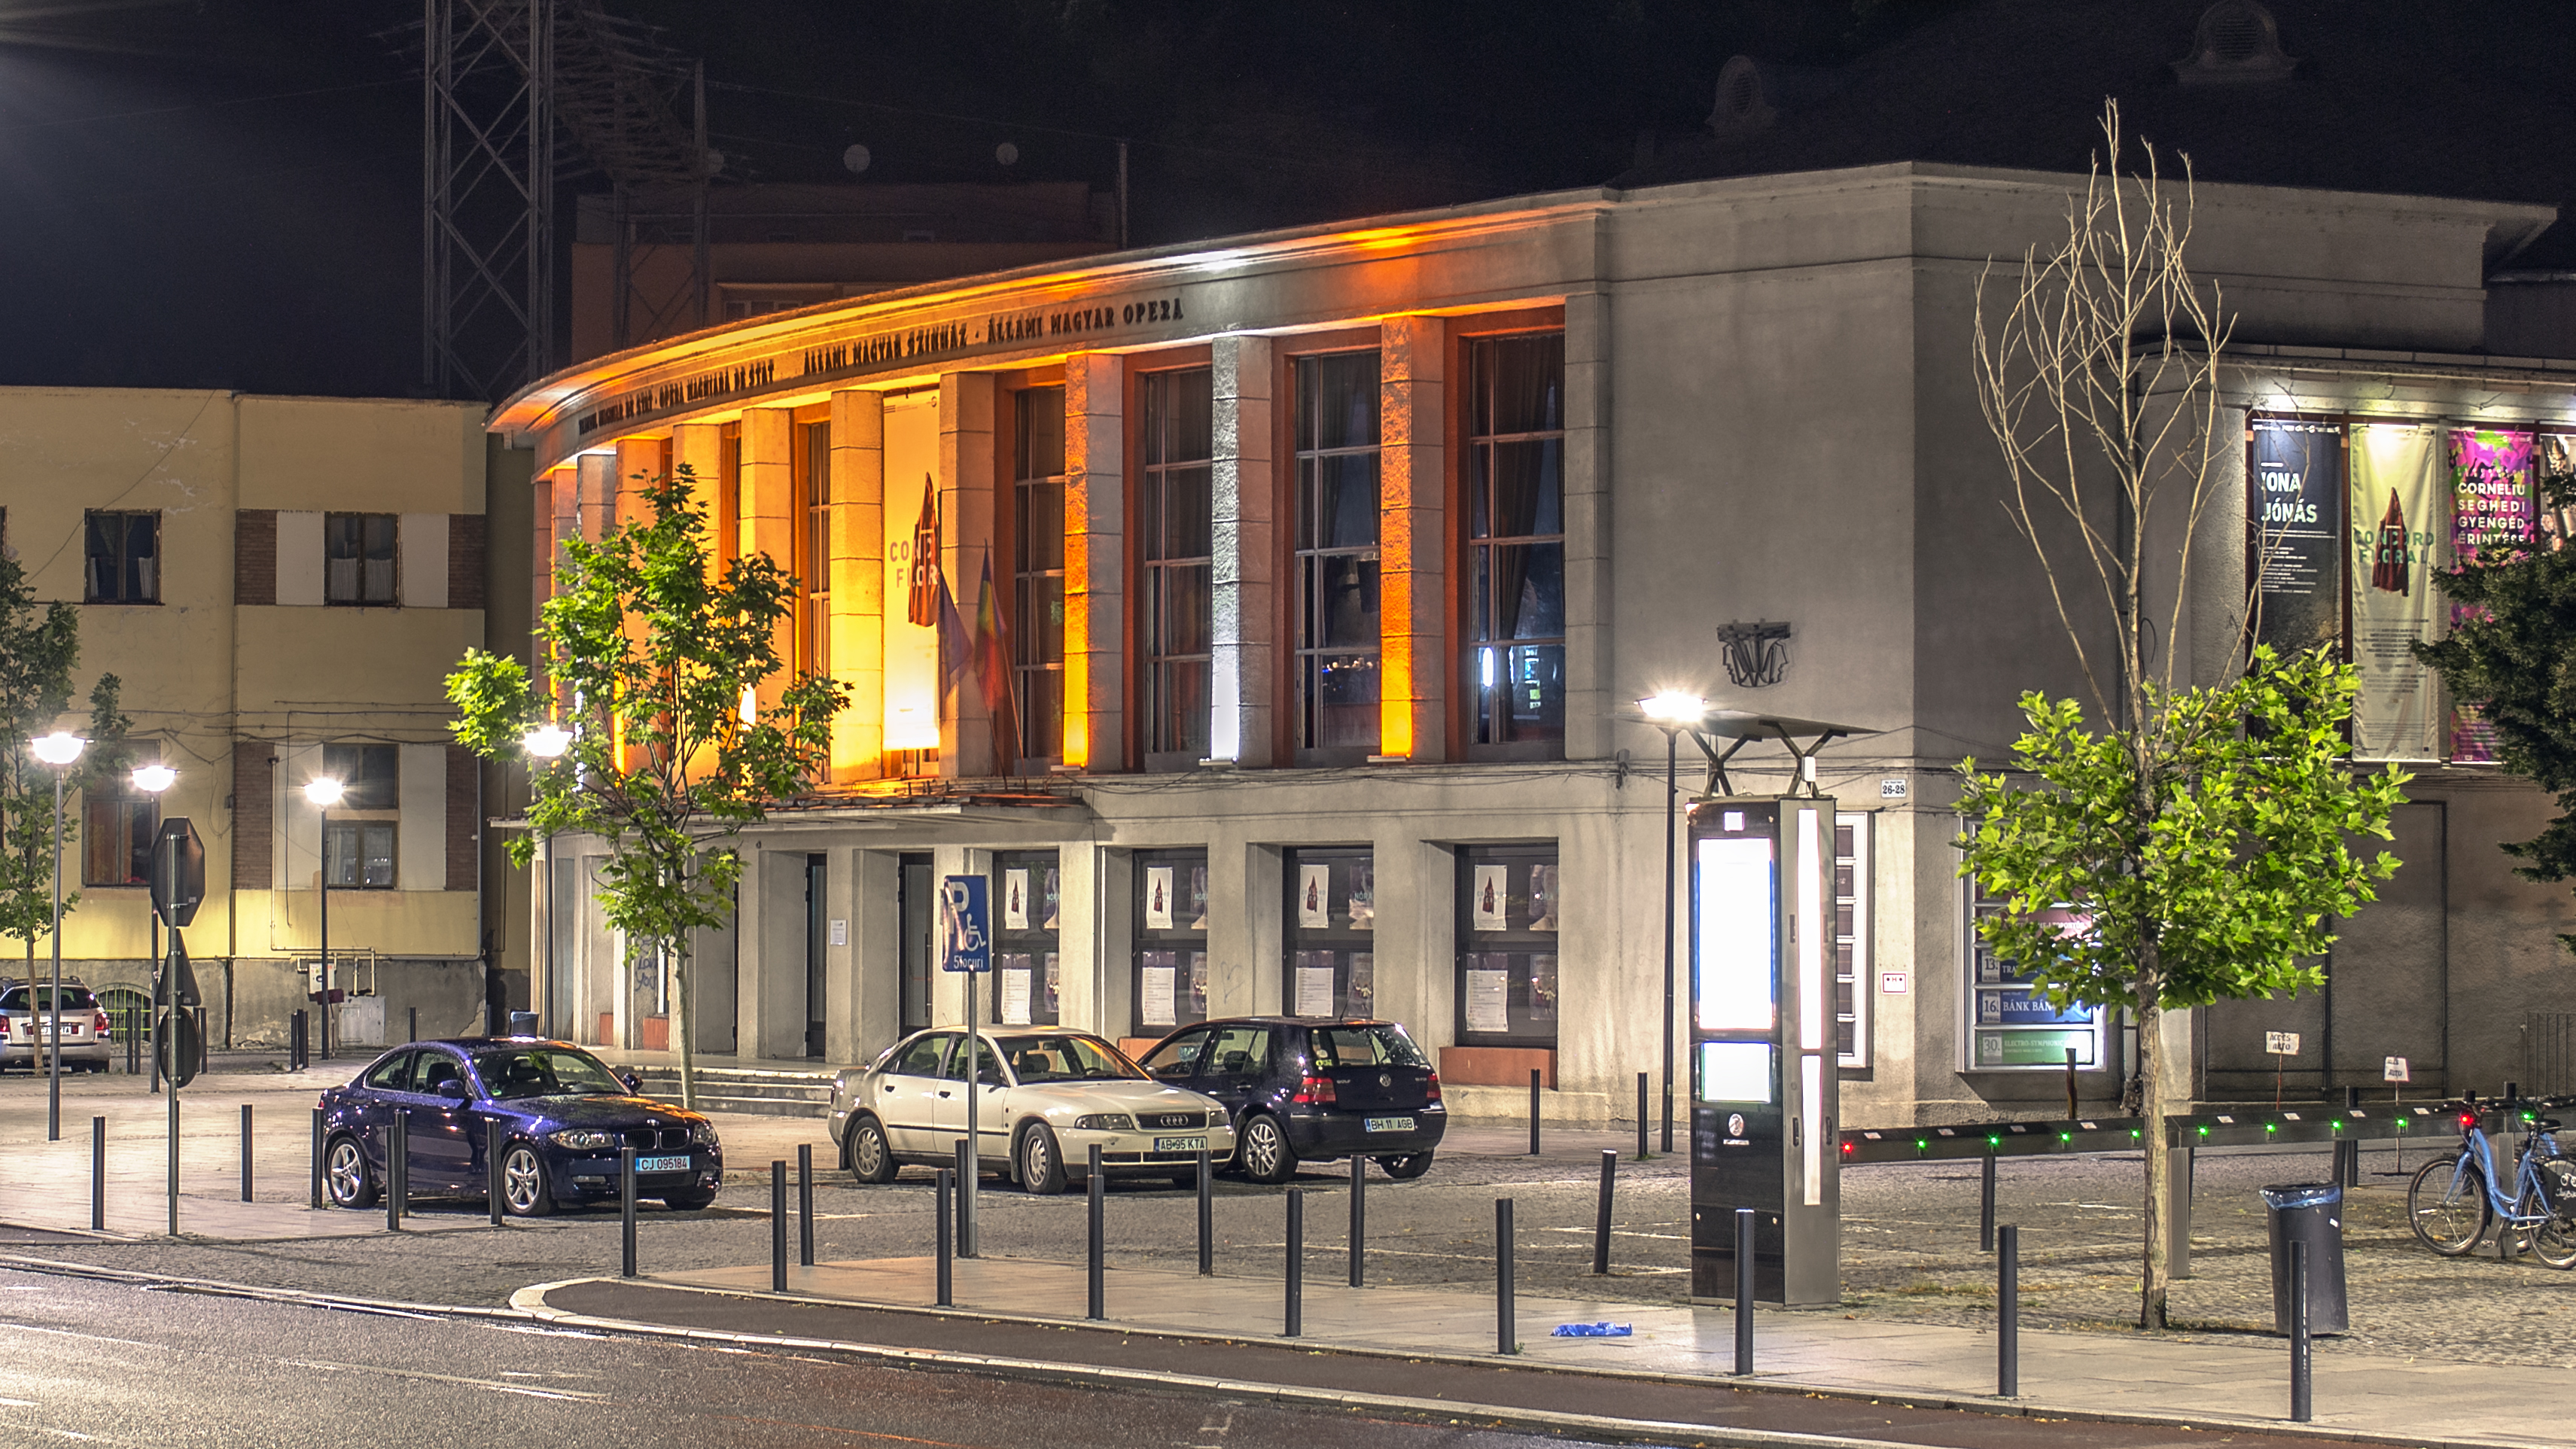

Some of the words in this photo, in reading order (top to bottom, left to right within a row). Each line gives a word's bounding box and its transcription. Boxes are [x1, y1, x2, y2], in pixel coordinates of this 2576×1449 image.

[853, 334, 902, 366] MAGYAR
[988, 316, 1043, 344] ÁLLAMI
[1050, 307, 1114, 335] MAGYAR
[1123, 298, 1183, 324] OPERA
[2458, 482, 2525, 495] CORNELIU
[2261, 498, 2317, 522] JÓNÁS
[2458, 499, 2525, 513] SEGHEDI
[2458, 516, 2525, 528] GYENGÉD
[1883, 785, 1905, 794] 26-28
[2003, 999, 2029, 1011] BÁNK
[1371, 1120, 1384, 1130] BH
[1385, 1119, 1393, 1129] 11
[1397, 1119, 1413, 1128] AGB
[1161, 1140, 1172, 1150] AB
[1175, 1139, 1186, 1149] 95
[1188, 1139, 1204, 1149] KTA
[641, 1159, 654, 1170] CJ
[657, 1158, 687, 1170] 095184
